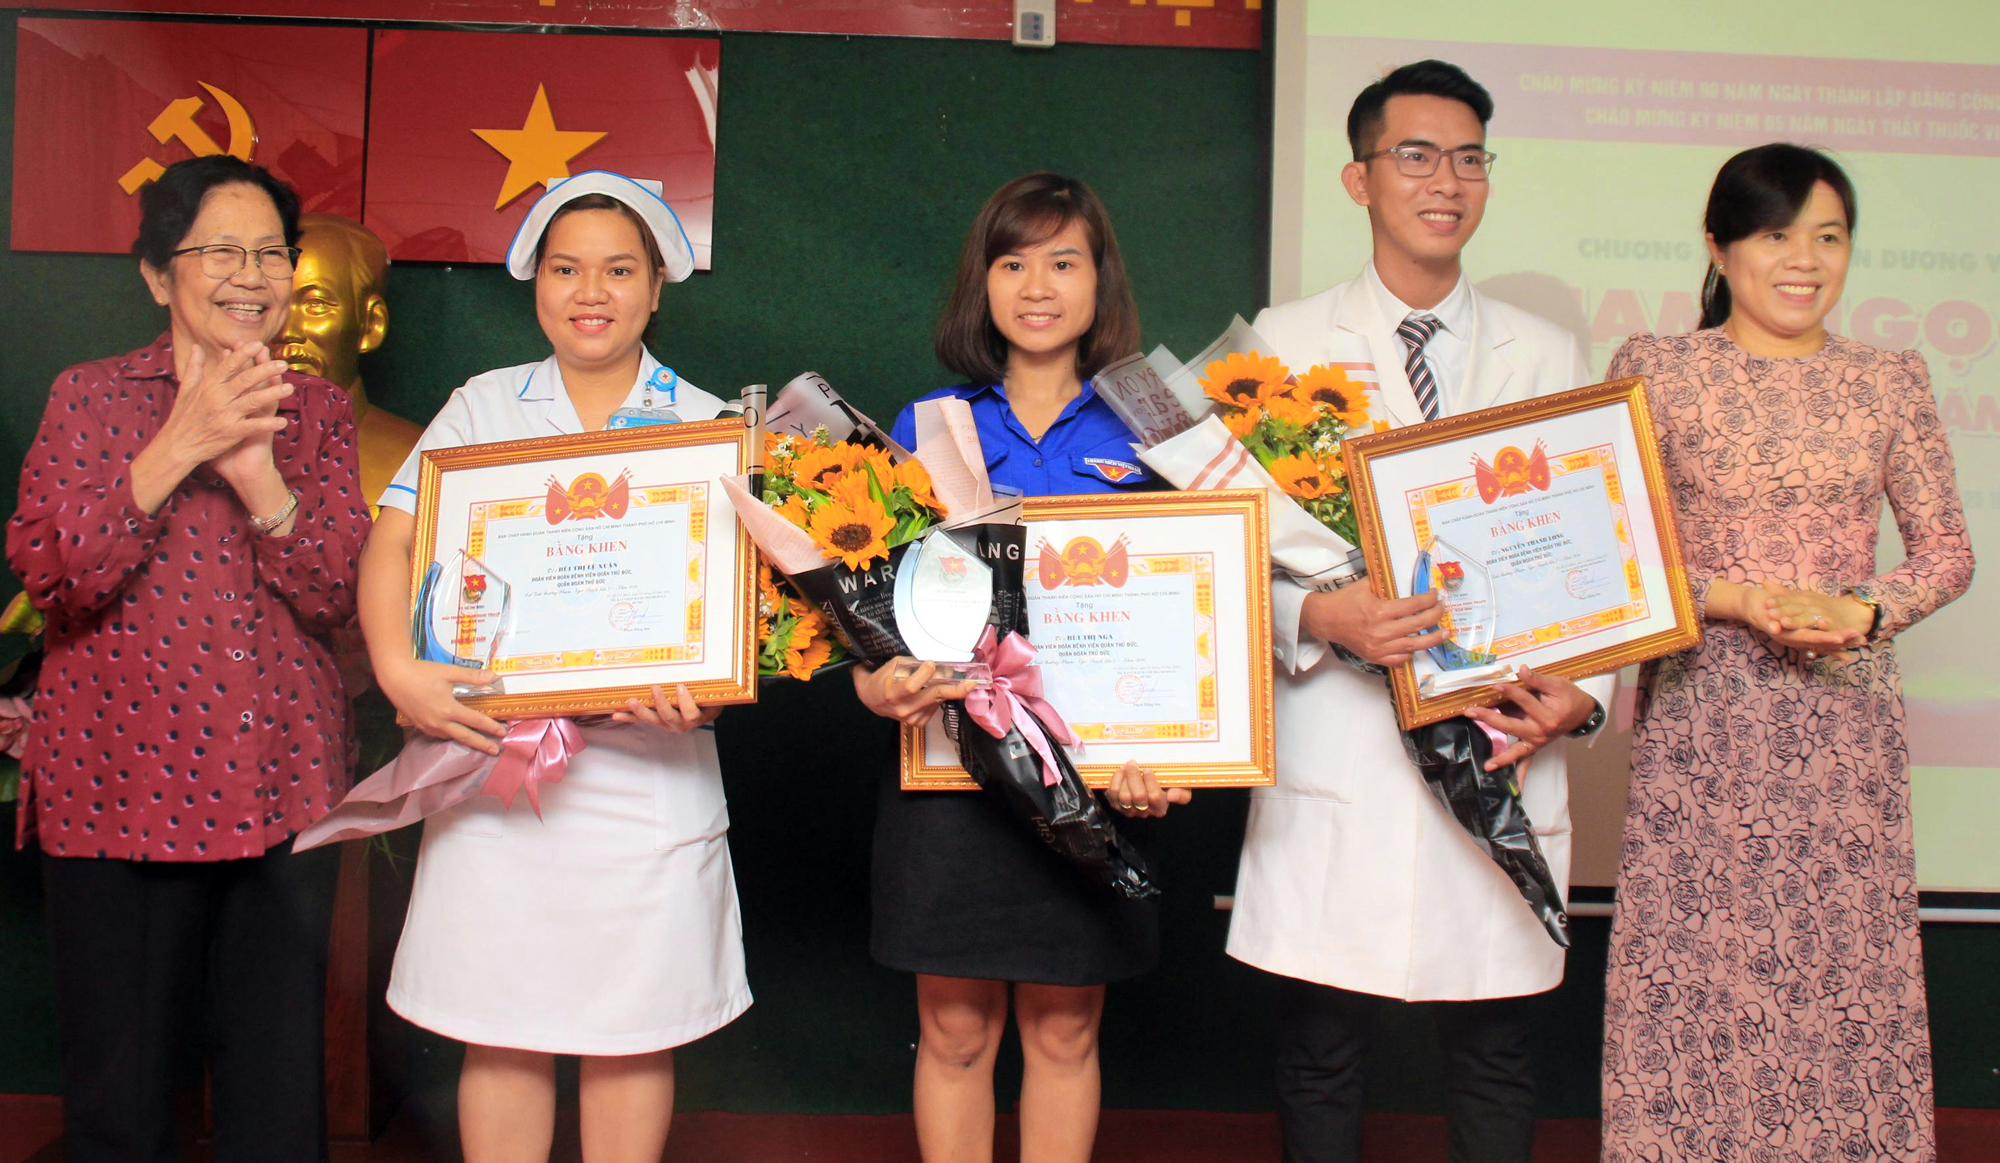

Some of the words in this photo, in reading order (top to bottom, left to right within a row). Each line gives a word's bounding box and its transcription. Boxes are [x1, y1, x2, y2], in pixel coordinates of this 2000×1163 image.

[1490, 519, 1525, 538] BẰNG
[1527, 511, 1562, 529] KHEN
[1527, 536, 1548, 546] THANH
[1548, 533, 1565, 542] LONG
[546, 540, 585, 558] BẰNG
[588, 540, 628, 554] KHEN
[1043, 607, 1085, 625] BẰNG
[1089, 610, 1131, 623] KHEN
